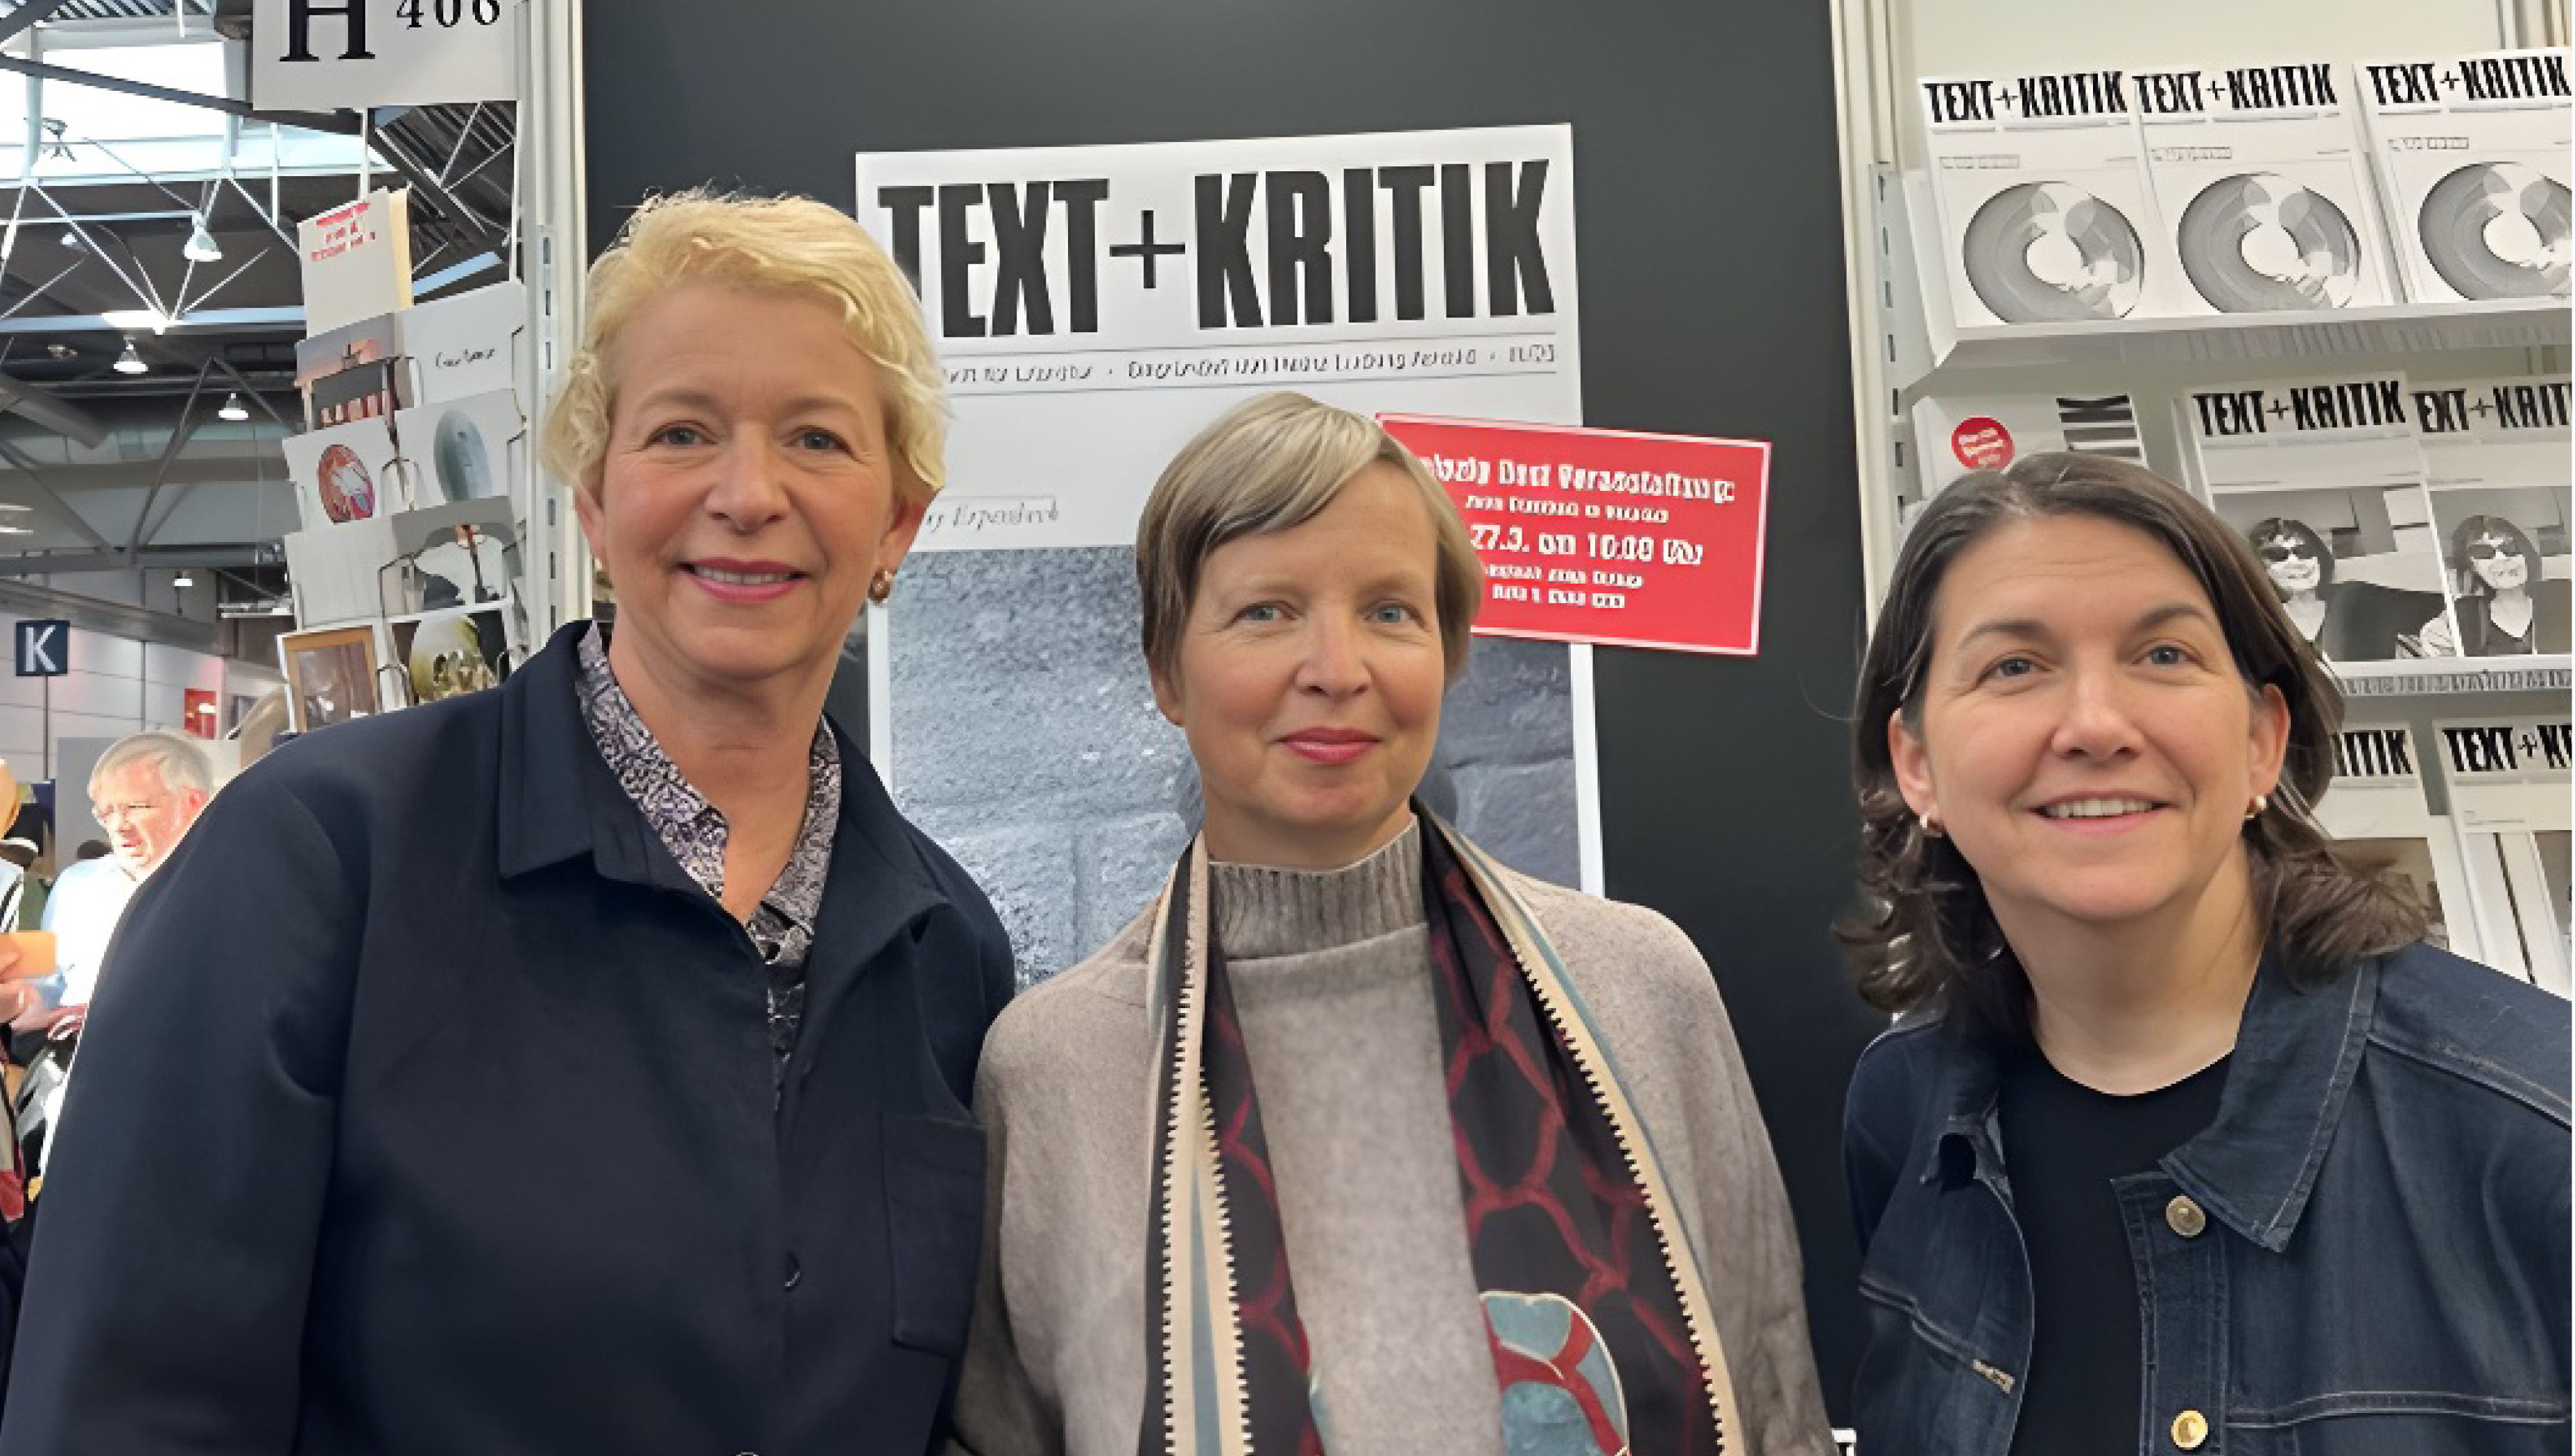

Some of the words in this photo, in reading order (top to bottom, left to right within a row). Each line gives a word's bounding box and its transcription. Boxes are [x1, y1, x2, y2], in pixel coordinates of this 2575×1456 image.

[279, 0, 375, 61] H
[1922, 71, 2128, 122] TEXT+KRITIK
[2132, 64, 2337, 113] TEXT+KRITIK
[2366, 56, 2572, 105] TEXT+KRITIK
[878, 159, 1554, 338] TEXT+KRITIK
[2192, 381, 2406, 436] TEXT+KRITIK
[2408, 381, 2572, 432] EXT+KRIT
[25, 625, 55, 673] K
